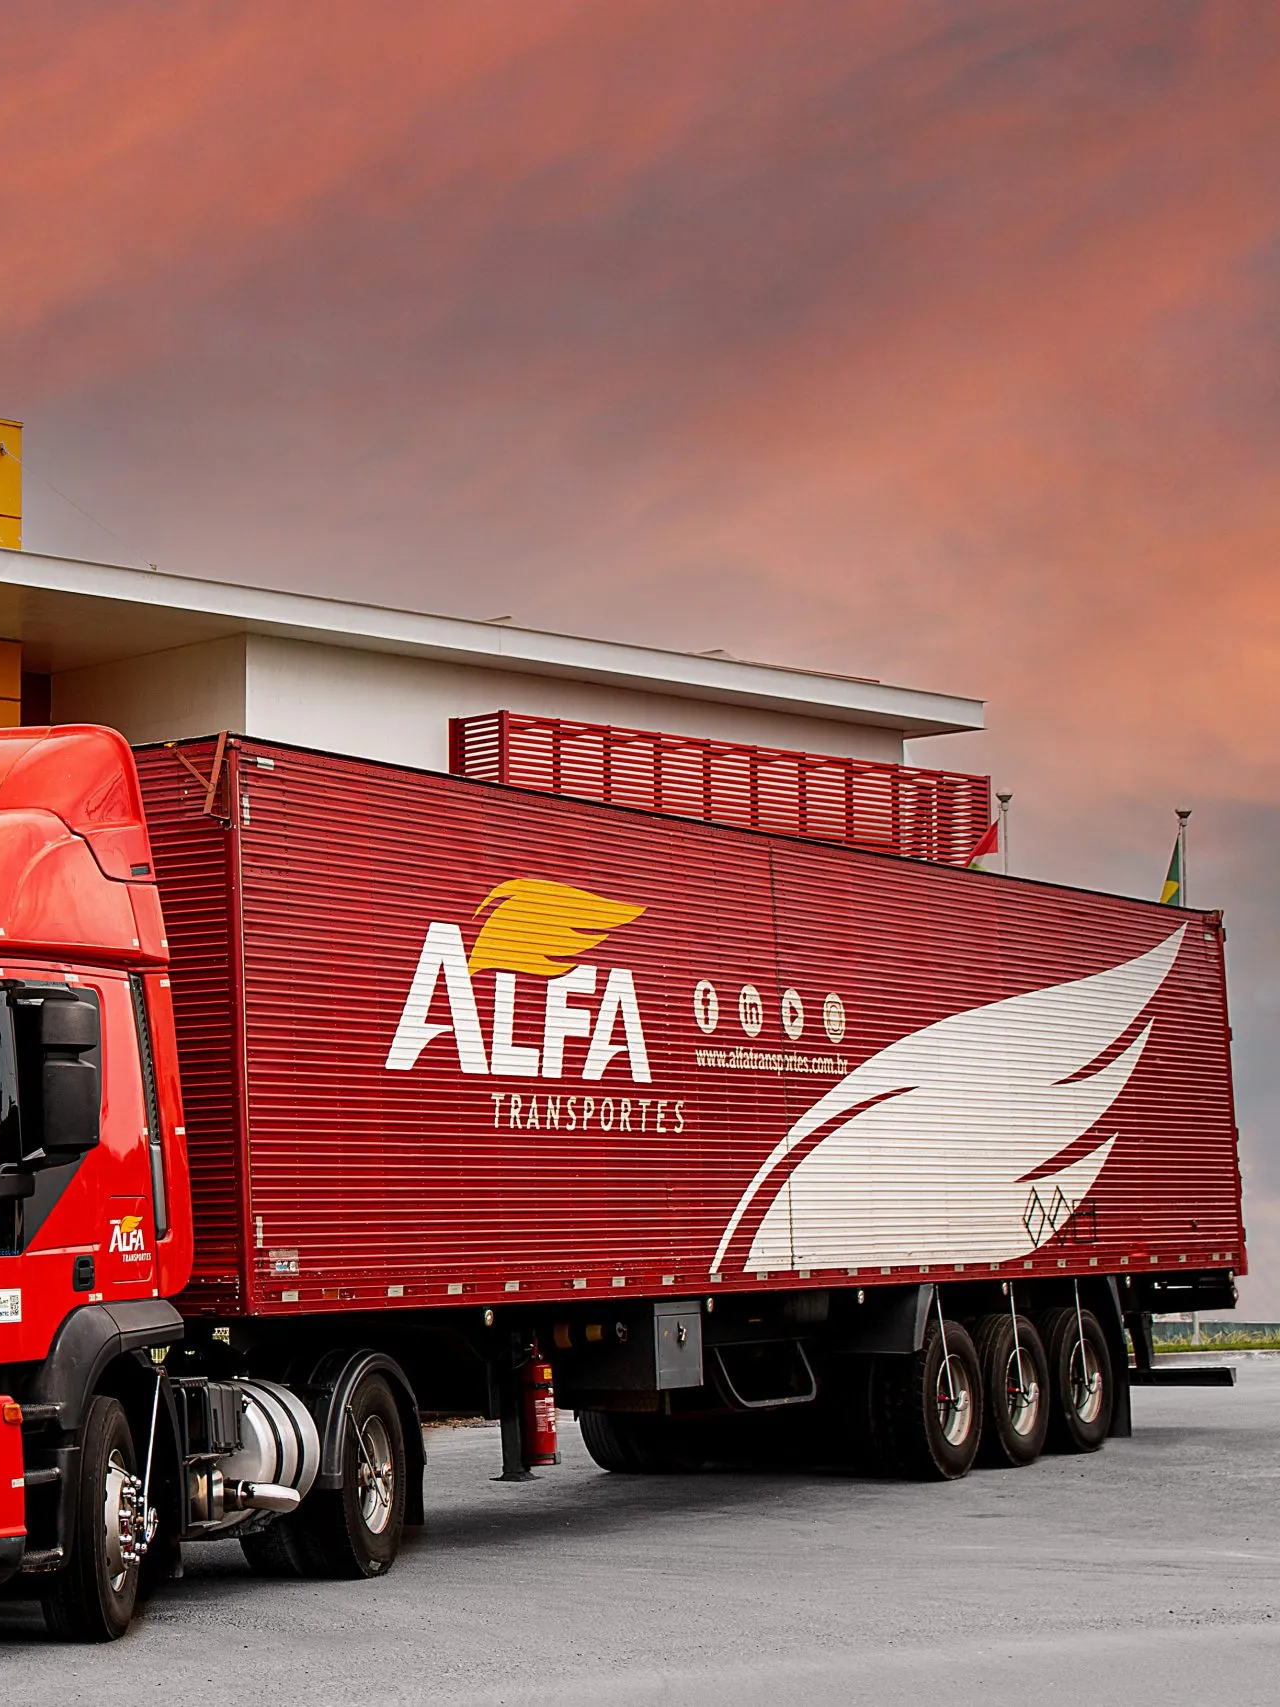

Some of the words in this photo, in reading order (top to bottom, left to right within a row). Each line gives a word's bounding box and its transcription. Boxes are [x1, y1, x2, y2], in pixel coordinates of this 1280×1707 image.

[385, 921, 652, 1083] ALFA
[695, 1046, 848, 1077] www.alfatransportes.com.br
[491, 1093, 685, 1133] TRANSPORTES
[109, 1224, 145, 1253] ALFA
